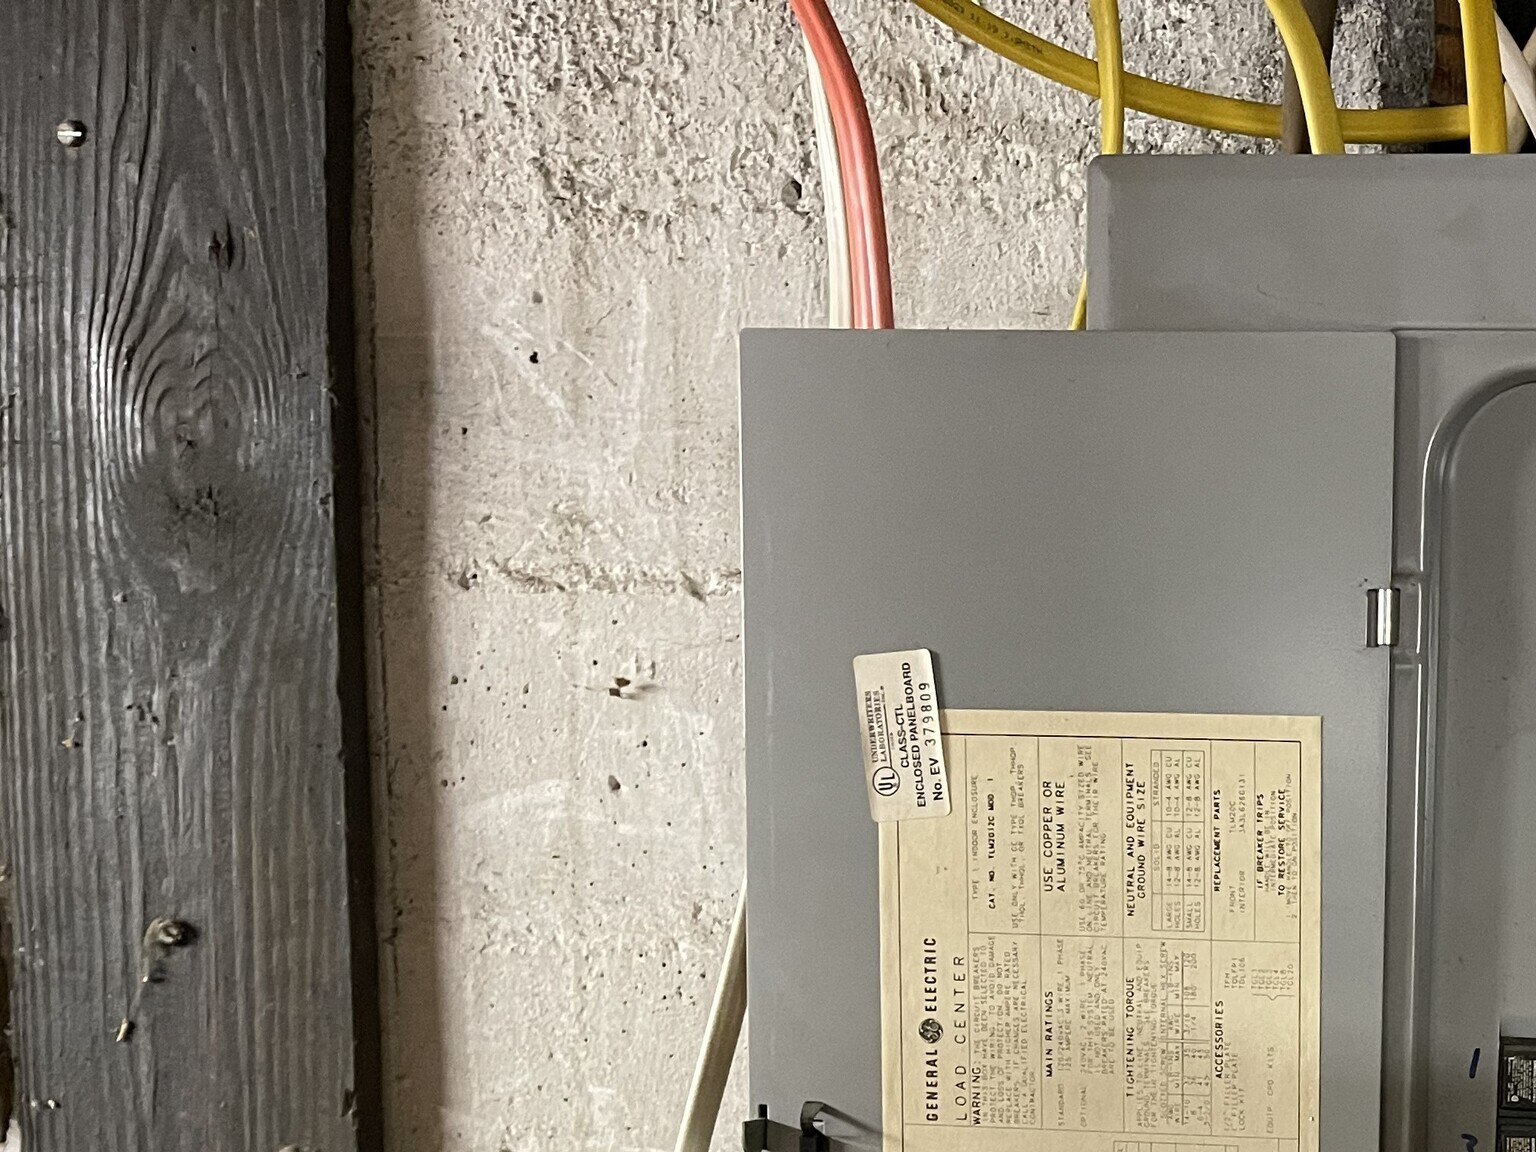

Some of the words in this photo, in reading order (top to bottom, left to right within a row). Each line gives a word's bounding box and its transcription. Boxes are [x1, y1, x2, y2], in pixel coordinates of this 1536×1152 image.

[902, 662, 919, 741] PANELBOARD
[918, 682, 936, 747] 379809
[865, 690, 878, 763] UNDERWRITERS
[873, 690, 887, 762] LABORATORIES
[895, 704, 909, 768] CLASS-CTL
[878, 773, 895, 791] UL
[911, 745, 926, 807] ENCLOSED
[929, 758, 940, 775] EV
[933, 779, 943, 801] No.
[1042, 780, 1053, 798] OR
[1055, 781, 1066, 816] WIRE
[1125, 762, 1135, 829] EQUIPMENT
[1136, 781, 1146, 810] SIZE
[1213, 789, 1221, 820] PARTS
[1256, 793, 1264, 823] TRIPS
[1277, 788, 1285, 831] SERVICE
[1043, 807, 1054, 858] COPPER
[1126, 835, 1135, 858] AND
[1137, 818, 1146, 848] WIRE
[1043, 863, 1054, 892] USE
[1056, 824, 1066, 892] ALUMINUM
[1137, 854, 1146, 899] GROUND
[1213, 825, 1222, 892] REPLACEMENT
[1278, 836, 1286, 879] RESTORE
[1126, 867, 1136, 917] NEUTRAL
[1257, 879, 1264, 889] IF
[1278, 884, 1286, 896] TO
[923, 937, 937, 1012] ELECTRIC
[1125, 977, 1134, 1019] TORQUE
[953, 955, 966, 1045] CENTER
[1044, 991, 1054, 1042] RATINGS
[1045, 1048, 1054, 1078] MAIN
[1125, 1025, 1135, 1098] TIGHTENING
[1215, 1000, 1224, 1079] ACCESSORIES
[1468, 1047, 1482, 1078] 1
[925, 1049, 939, 1122] GENERAL
[954, 1064, 967, 1121] LOAD
[972, 1061, 981, 1125] WARNING:
